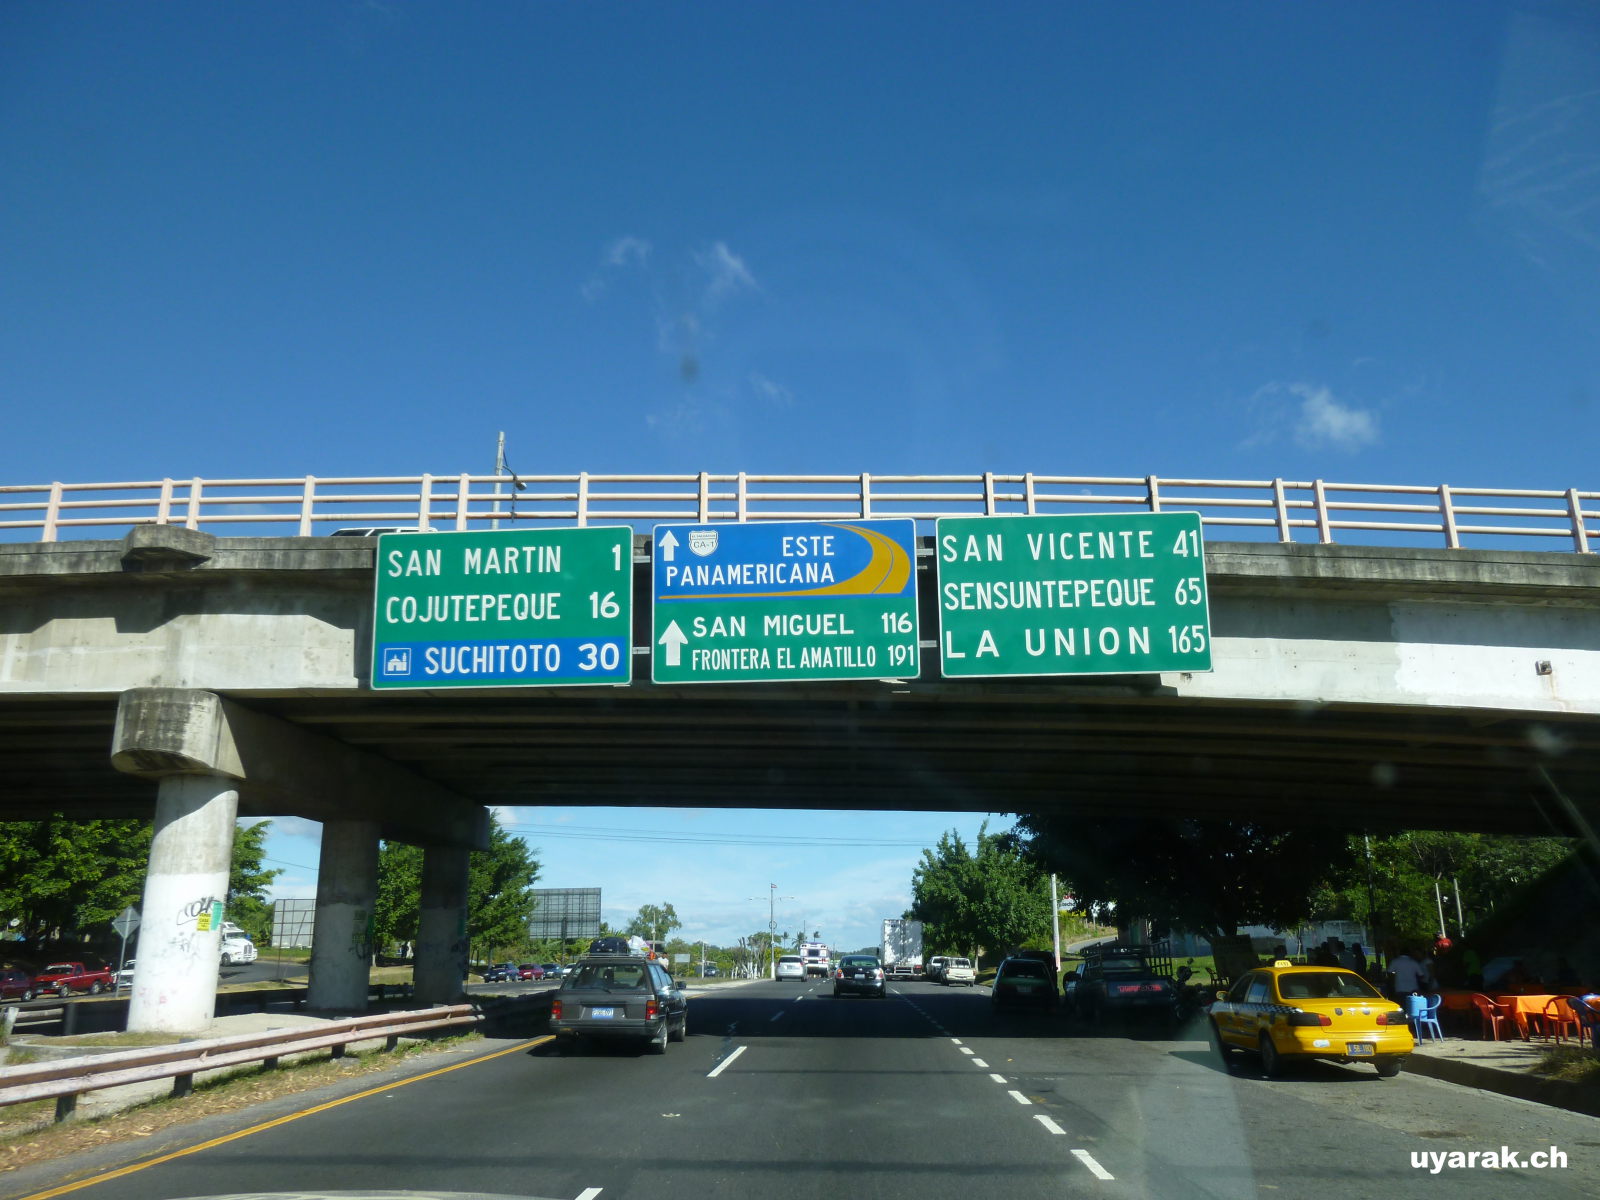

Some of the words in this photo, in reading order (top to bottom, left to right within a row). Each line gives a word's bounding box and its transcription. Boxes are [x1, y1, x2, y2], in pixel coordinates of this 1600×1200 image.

[388, 550, 441, 577] SAN
[464, 546, 561, 574] MARTIN
[611, 544, 621, 571] 1
[782, 536, 835, 557] ESTE
[942, 534, 1003, 562] SAN
[1027, 531, 1154, 560] VICENTE
[1172, 529, 1199, 557] 41
[666, 562, 835, 587] PANAMERICANA
[386, 593, 561, 623] COJUTEPEQUE
[589, 592, 620, 619] 16
[944, 579, 1155, 610] SENSUNTEPEQUE
[1174, 578, 1202, 605] 65
[693, 616, 746, 637] SAN
[763, 613, 854, 636] MIGUEL
[881, 612, 913, 633] 116
[946, 630, 1000, 658] LA
[1025, 627, 1150, 656] UNION
[1168, 625, 1206, 653] 165
[425, 644, 560, 674] SUCHITOTO
[578, 643, 620, 671] 30
[692, 648, 770, 671] FRONTERA
[777, 648, 796, 669] EL
[800, 646, 876, 669] AMATILLO
[887, 645, 914, 667] 191
